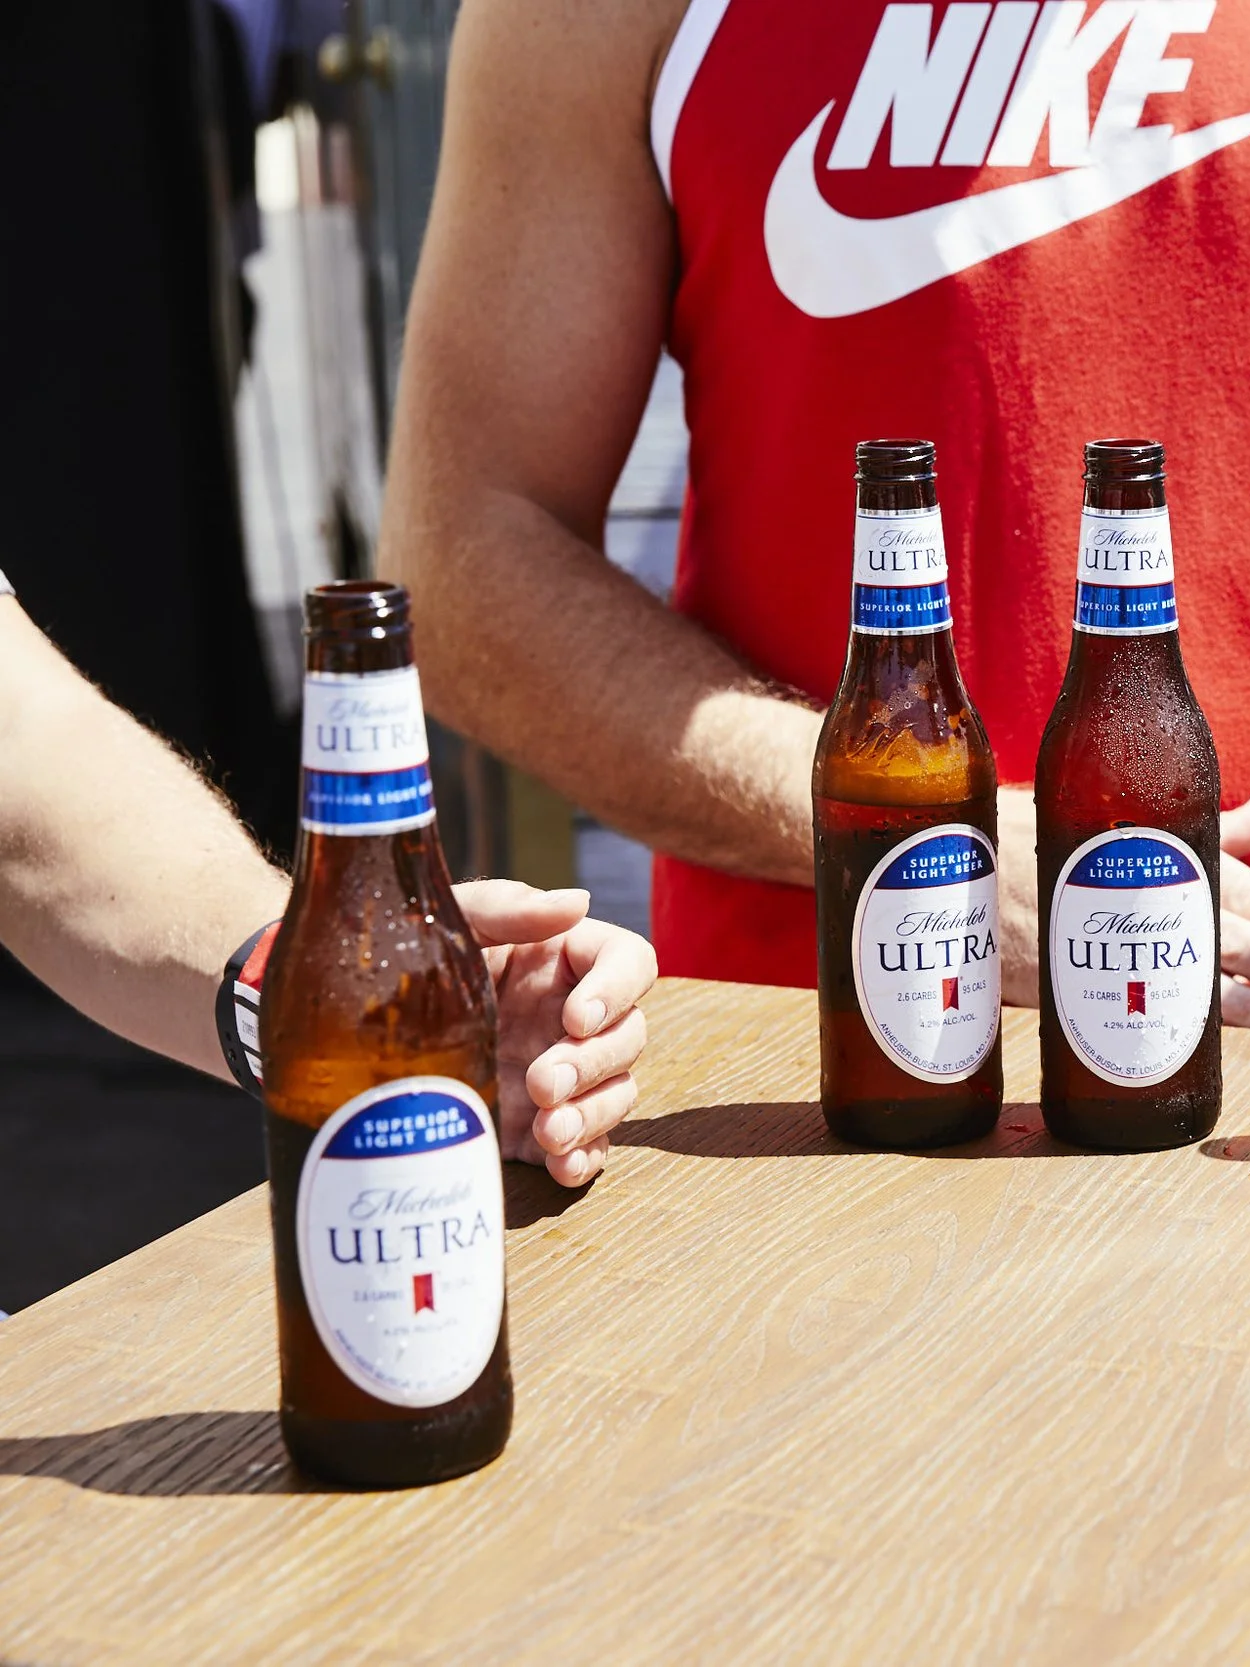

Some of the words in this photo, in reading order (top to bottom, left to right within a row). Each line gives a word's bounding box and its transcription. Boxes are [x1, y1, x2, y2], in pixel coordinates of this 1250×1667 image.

[827, 0, 1217, 170] NIKE
[1085, 548, 1168, 571] ULTRA
[860, 602, 912, 612] SUPERIOR
[917, 599, 944, 611] LIGHT
[1080, 600, 1120, 612] UPERIOR
[1126, 601, 1158, 612] LIGHT
[910, 850, 978, 868] SUPERIOR
[1096, 855, 1173, 868] SUPERIOR
[902, 867, 947, 880] LIGHT
[955, 859, 984, 875] BEER
[1090, 868, 1135, 879] LIGHT
[1144, 865, 1179, 878] BEER
[896, 904, 987, 936] Michelob
[1083, 911, 1184, 935] Michelob
[877, 928, 996, 972] ULTRA
[1067, 937, 1199, 971] ULTRA
[897, 992, 910, 1002] 2.6
[911, 990, 937, 1001] CARBS
[963, 986, 971, 994] 95
[972, 980, 986, 992] CALS
[1083, 990, 1095, 999] 2.6
[1096, 991, 1121, 1001] CARBS
[1150, 991, 1160, 1000] 95
[1162, 988, 1180, 999] CALS
[1104, 1021, 1124, 1029] 4.2%
[363, 1107, 460, 1133] SUPERIOR
[354, 1131, 415, 1149] LIGHT
[425, 1118, 468, 1143] BEER
[328, 1211, 491, 1264] ULTRA
